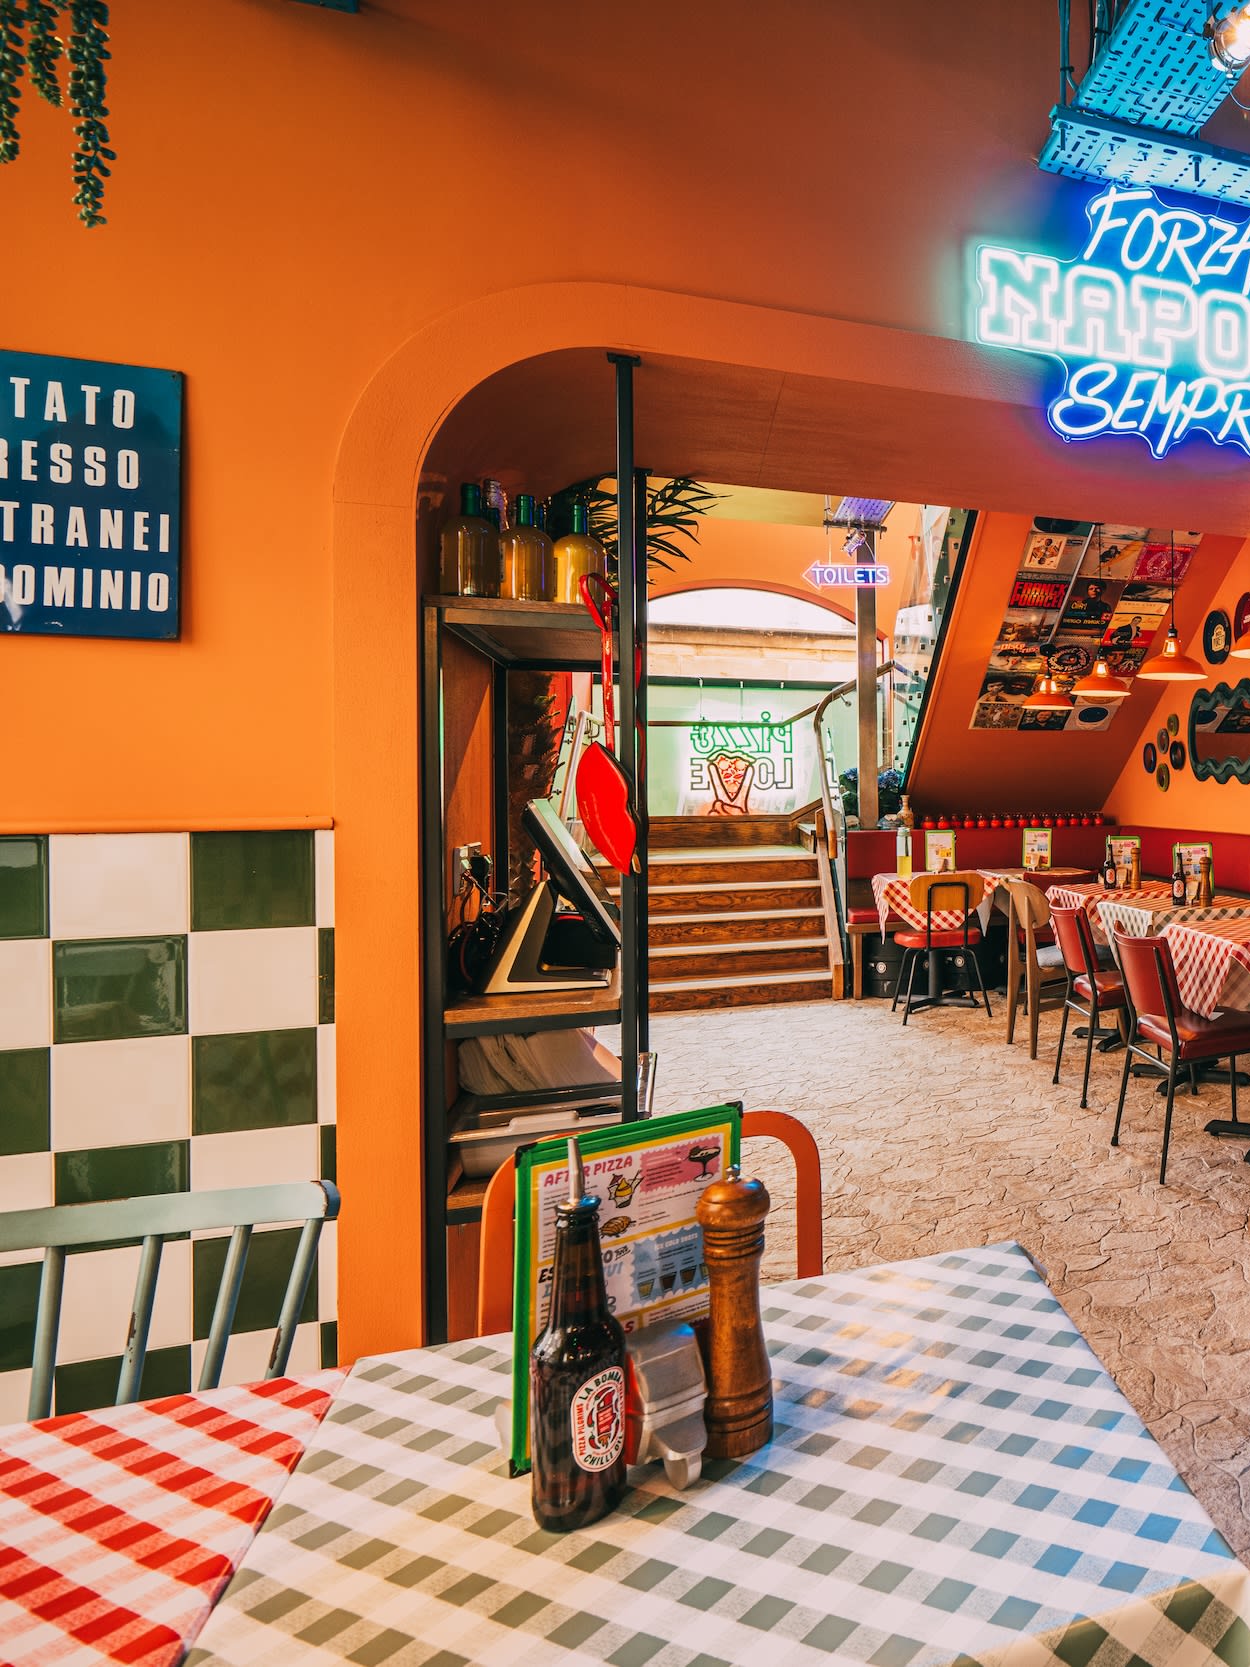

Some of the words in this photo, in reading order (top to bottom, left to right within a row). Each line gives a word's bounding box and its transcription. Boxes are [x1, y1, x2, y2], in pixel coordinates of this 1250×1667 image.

[10, 376, 136, 430] TATO
[0, 502, 170, 553] TRANEI
[0, 564, 169, 612] OMINIO
[811, 567, 887, 584] TOILETS
[544, 1165, 590, 1187] AFTR
[593, 1155, 633, 1176] PIZZA
[579, 1386, 594, 1400] LA
